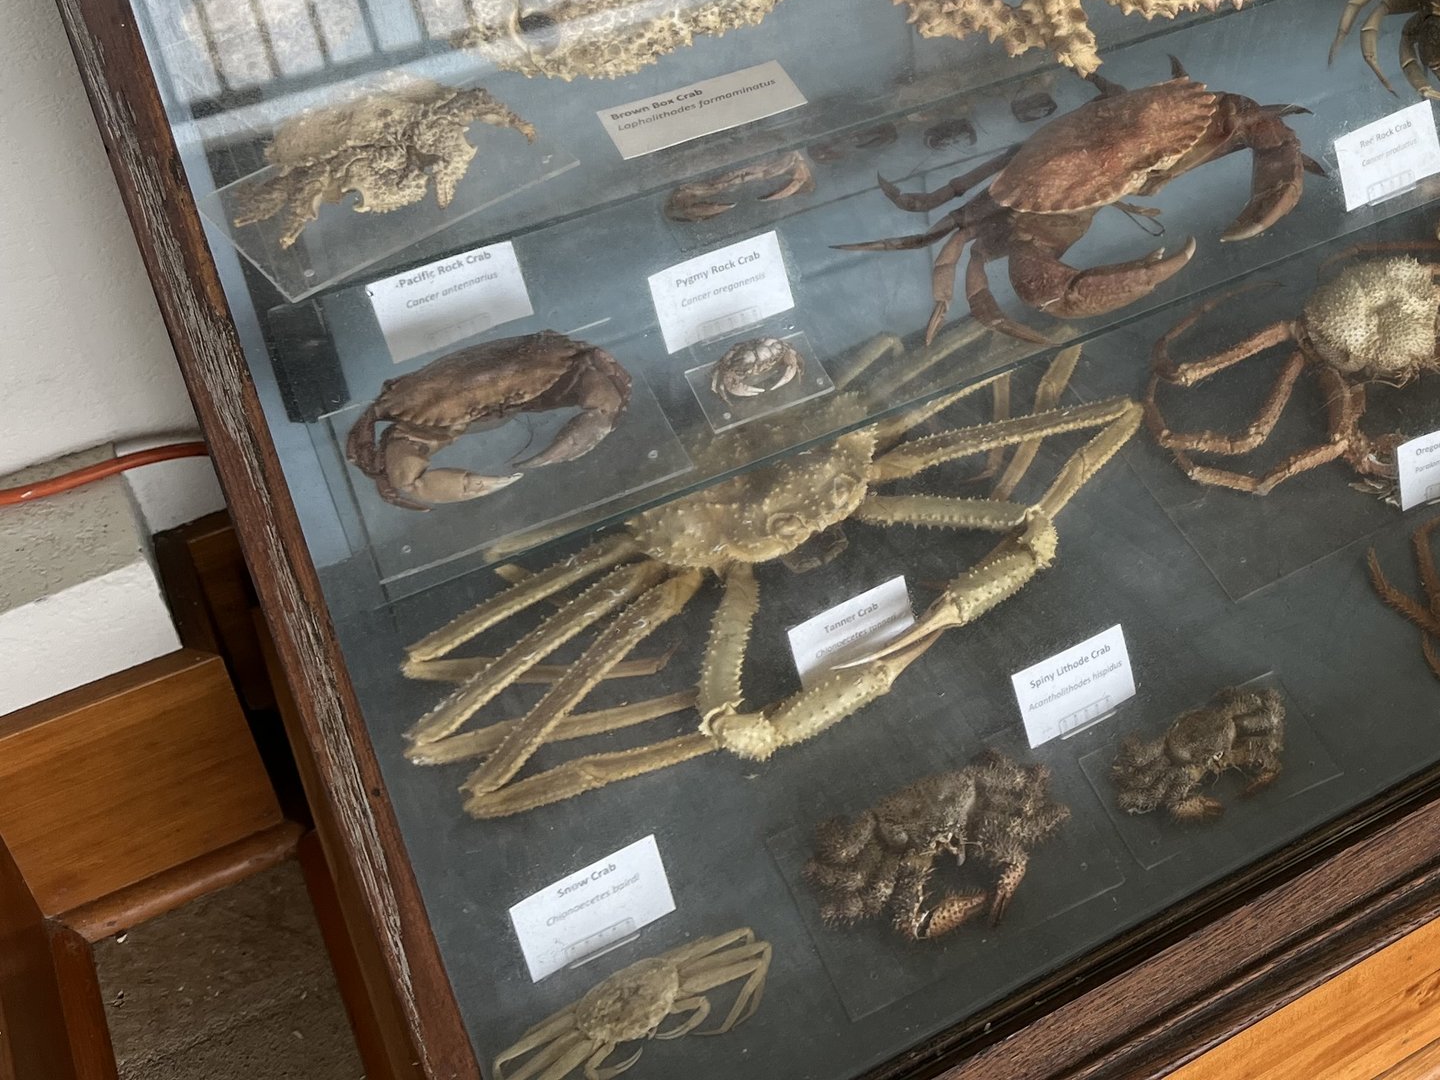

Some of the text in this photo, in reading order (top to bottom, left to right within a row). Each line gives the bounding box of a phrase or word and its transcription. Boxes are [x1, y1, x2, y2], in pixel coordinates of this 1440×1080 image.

[610, 88, 703, 121] Brown Box Crab
[617, 102, 697, 132] Lopholithodes
[1376, 120, 1412, 142] Rock Crab
[399, 251, 492, 289] Pacific Rock Crab
[675, 251, 761, 289] Pygmy Rock Crab
[406, 271, 498, 310] Cancer antennarius
[681, 271, 766, 308] Cancer oregonensis
[824, 602, 879, 634] Tanner Crab
[1029, 643, 1111, 690] Spiny Lithode Crab
[1028, 659, 1123, 712] Acantholithodes hispidus
[556, 863, 617, 898] Snow Crab
